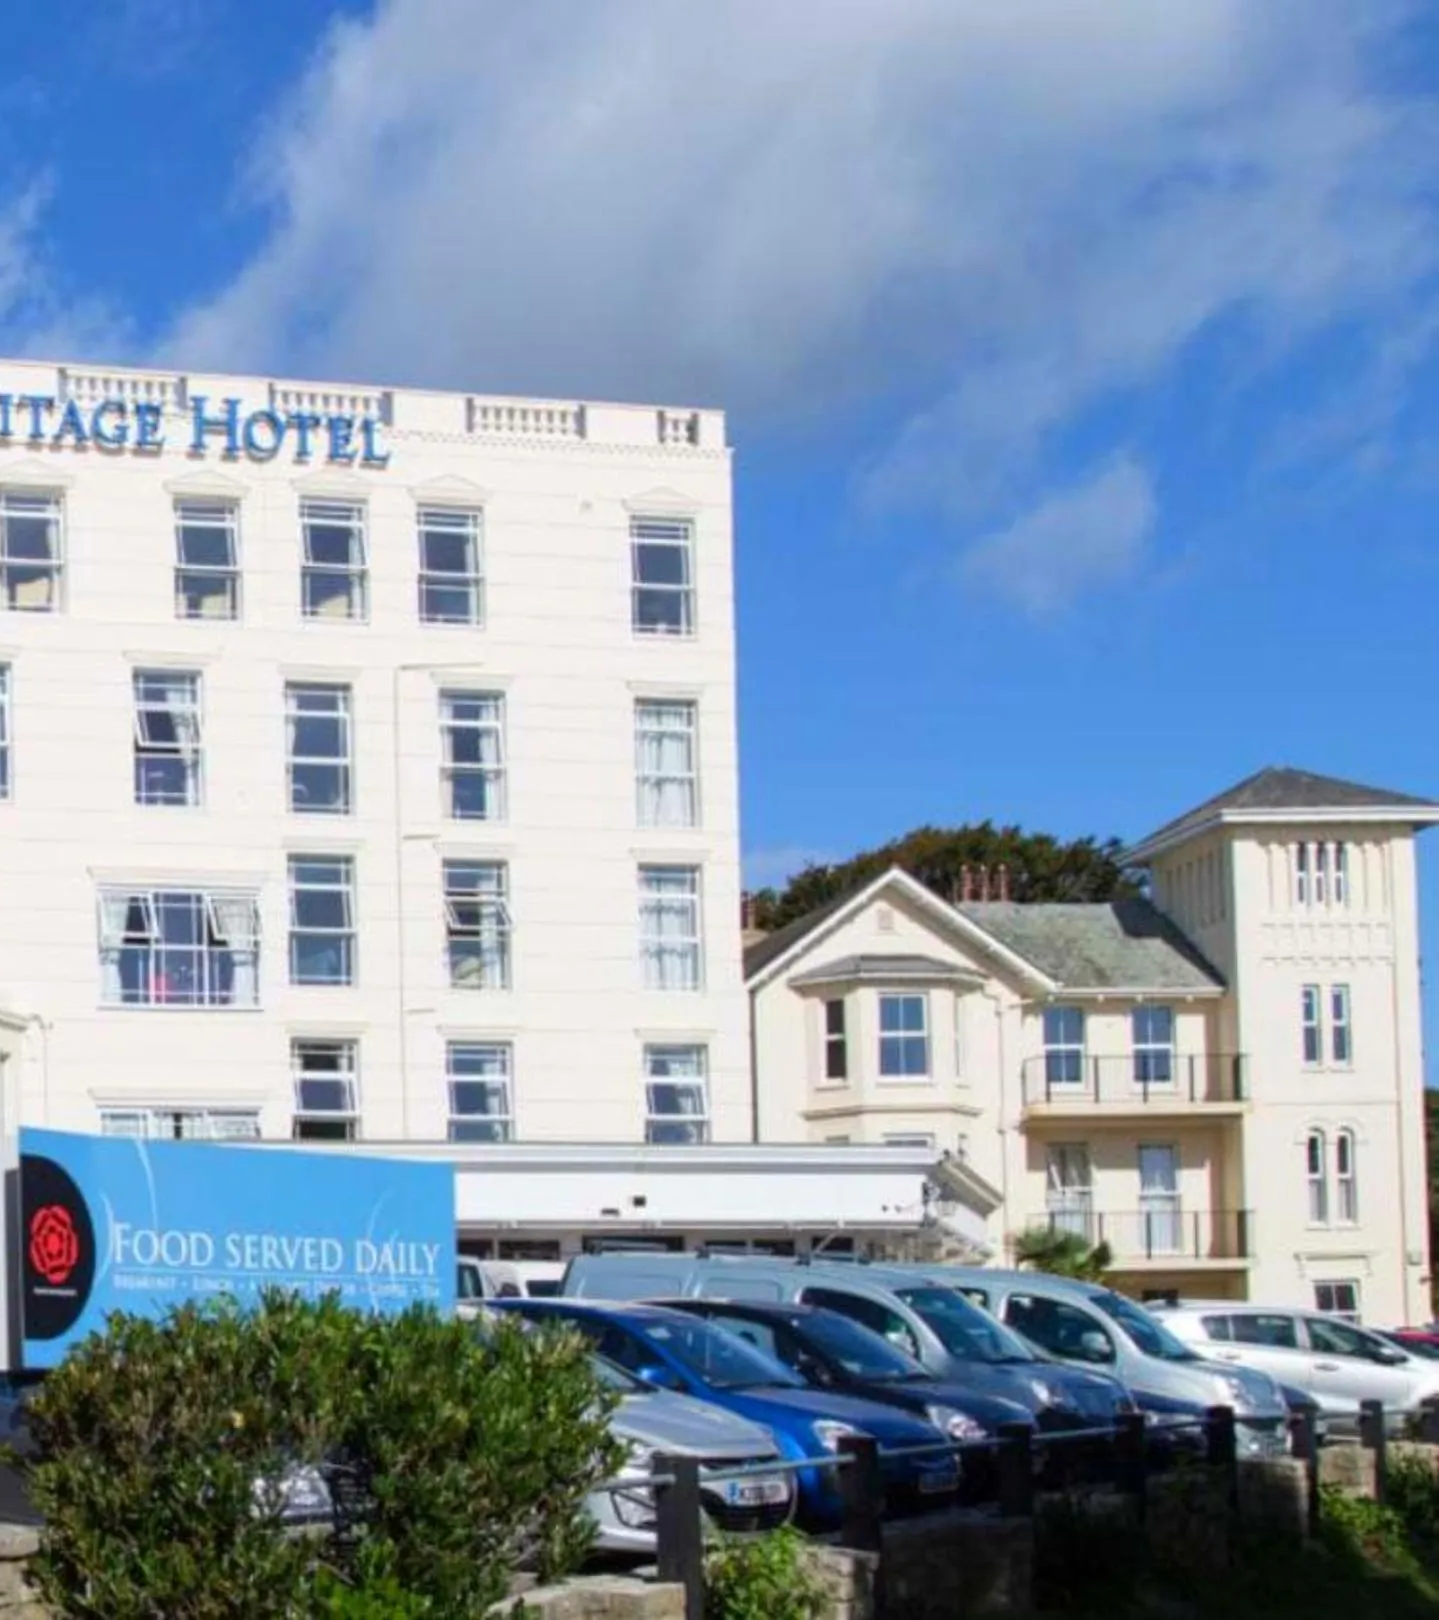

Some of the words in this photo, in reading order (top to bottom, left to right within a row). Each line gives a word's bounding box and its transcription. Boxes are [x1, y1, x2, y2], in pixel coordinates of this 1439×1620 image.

[188, 395, 391, 466] HOTEL
[112, 1221, 215, 1268] FOOD
[224, 1231, 343, 1274] SERVED
[356, 1239, 441, 1277] DAILY
